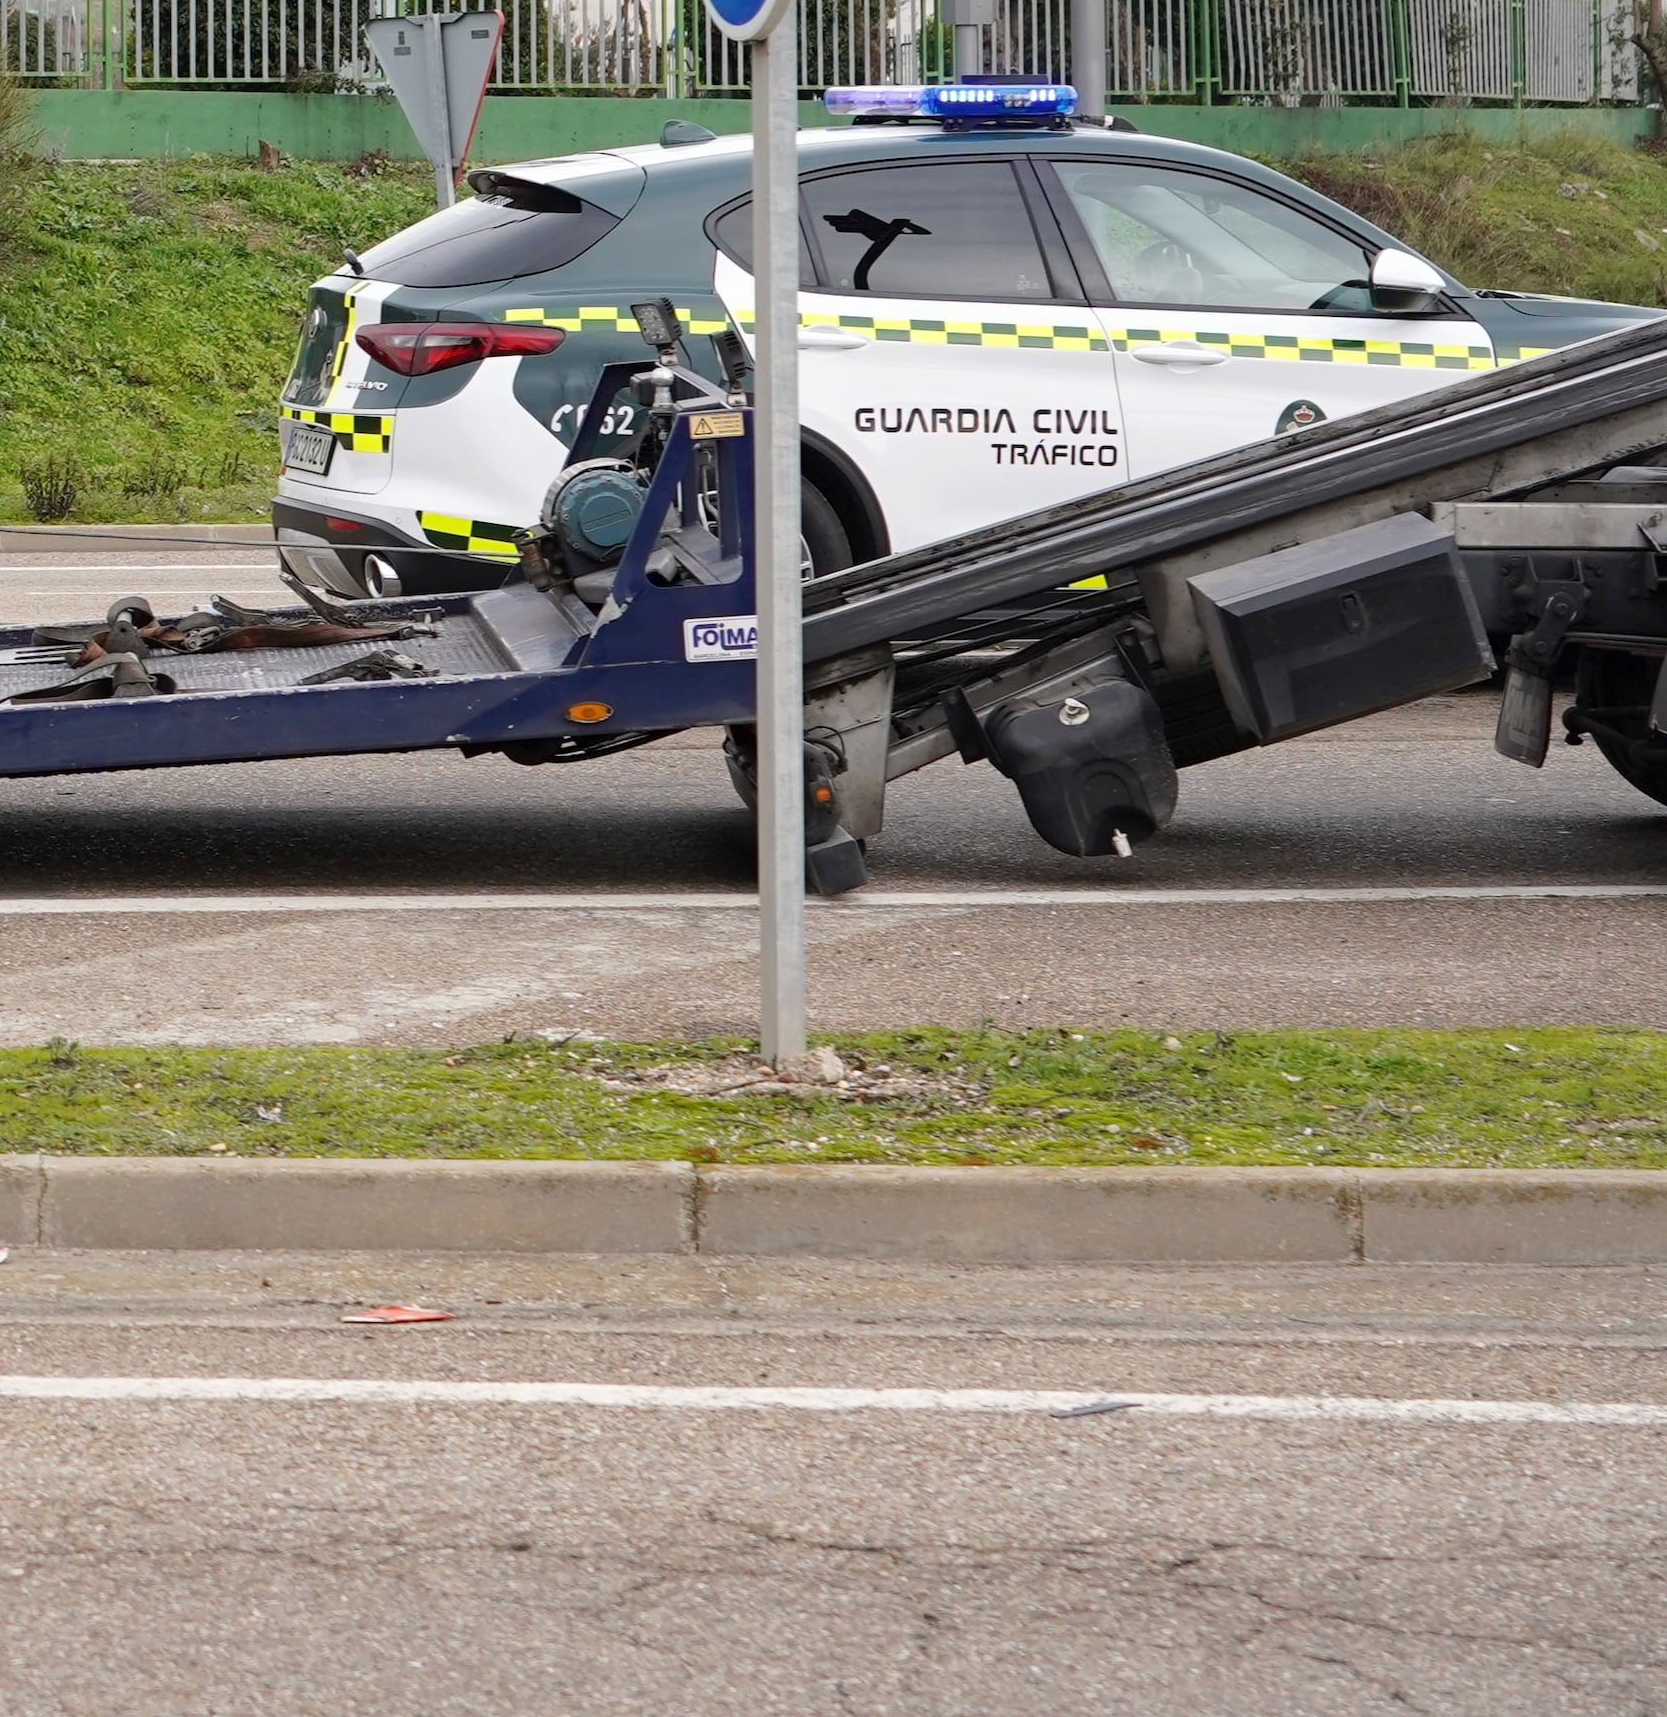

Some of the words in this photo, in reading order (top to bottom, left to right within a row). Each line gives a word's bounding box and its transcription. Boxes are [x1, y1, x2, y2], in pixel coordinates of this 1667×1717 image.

[855, 408, 1016, 433] GUARDIA
[1033, 409, 1118, 435] CIVIL
[991, 438, 1117, 466] TRÁFICO
